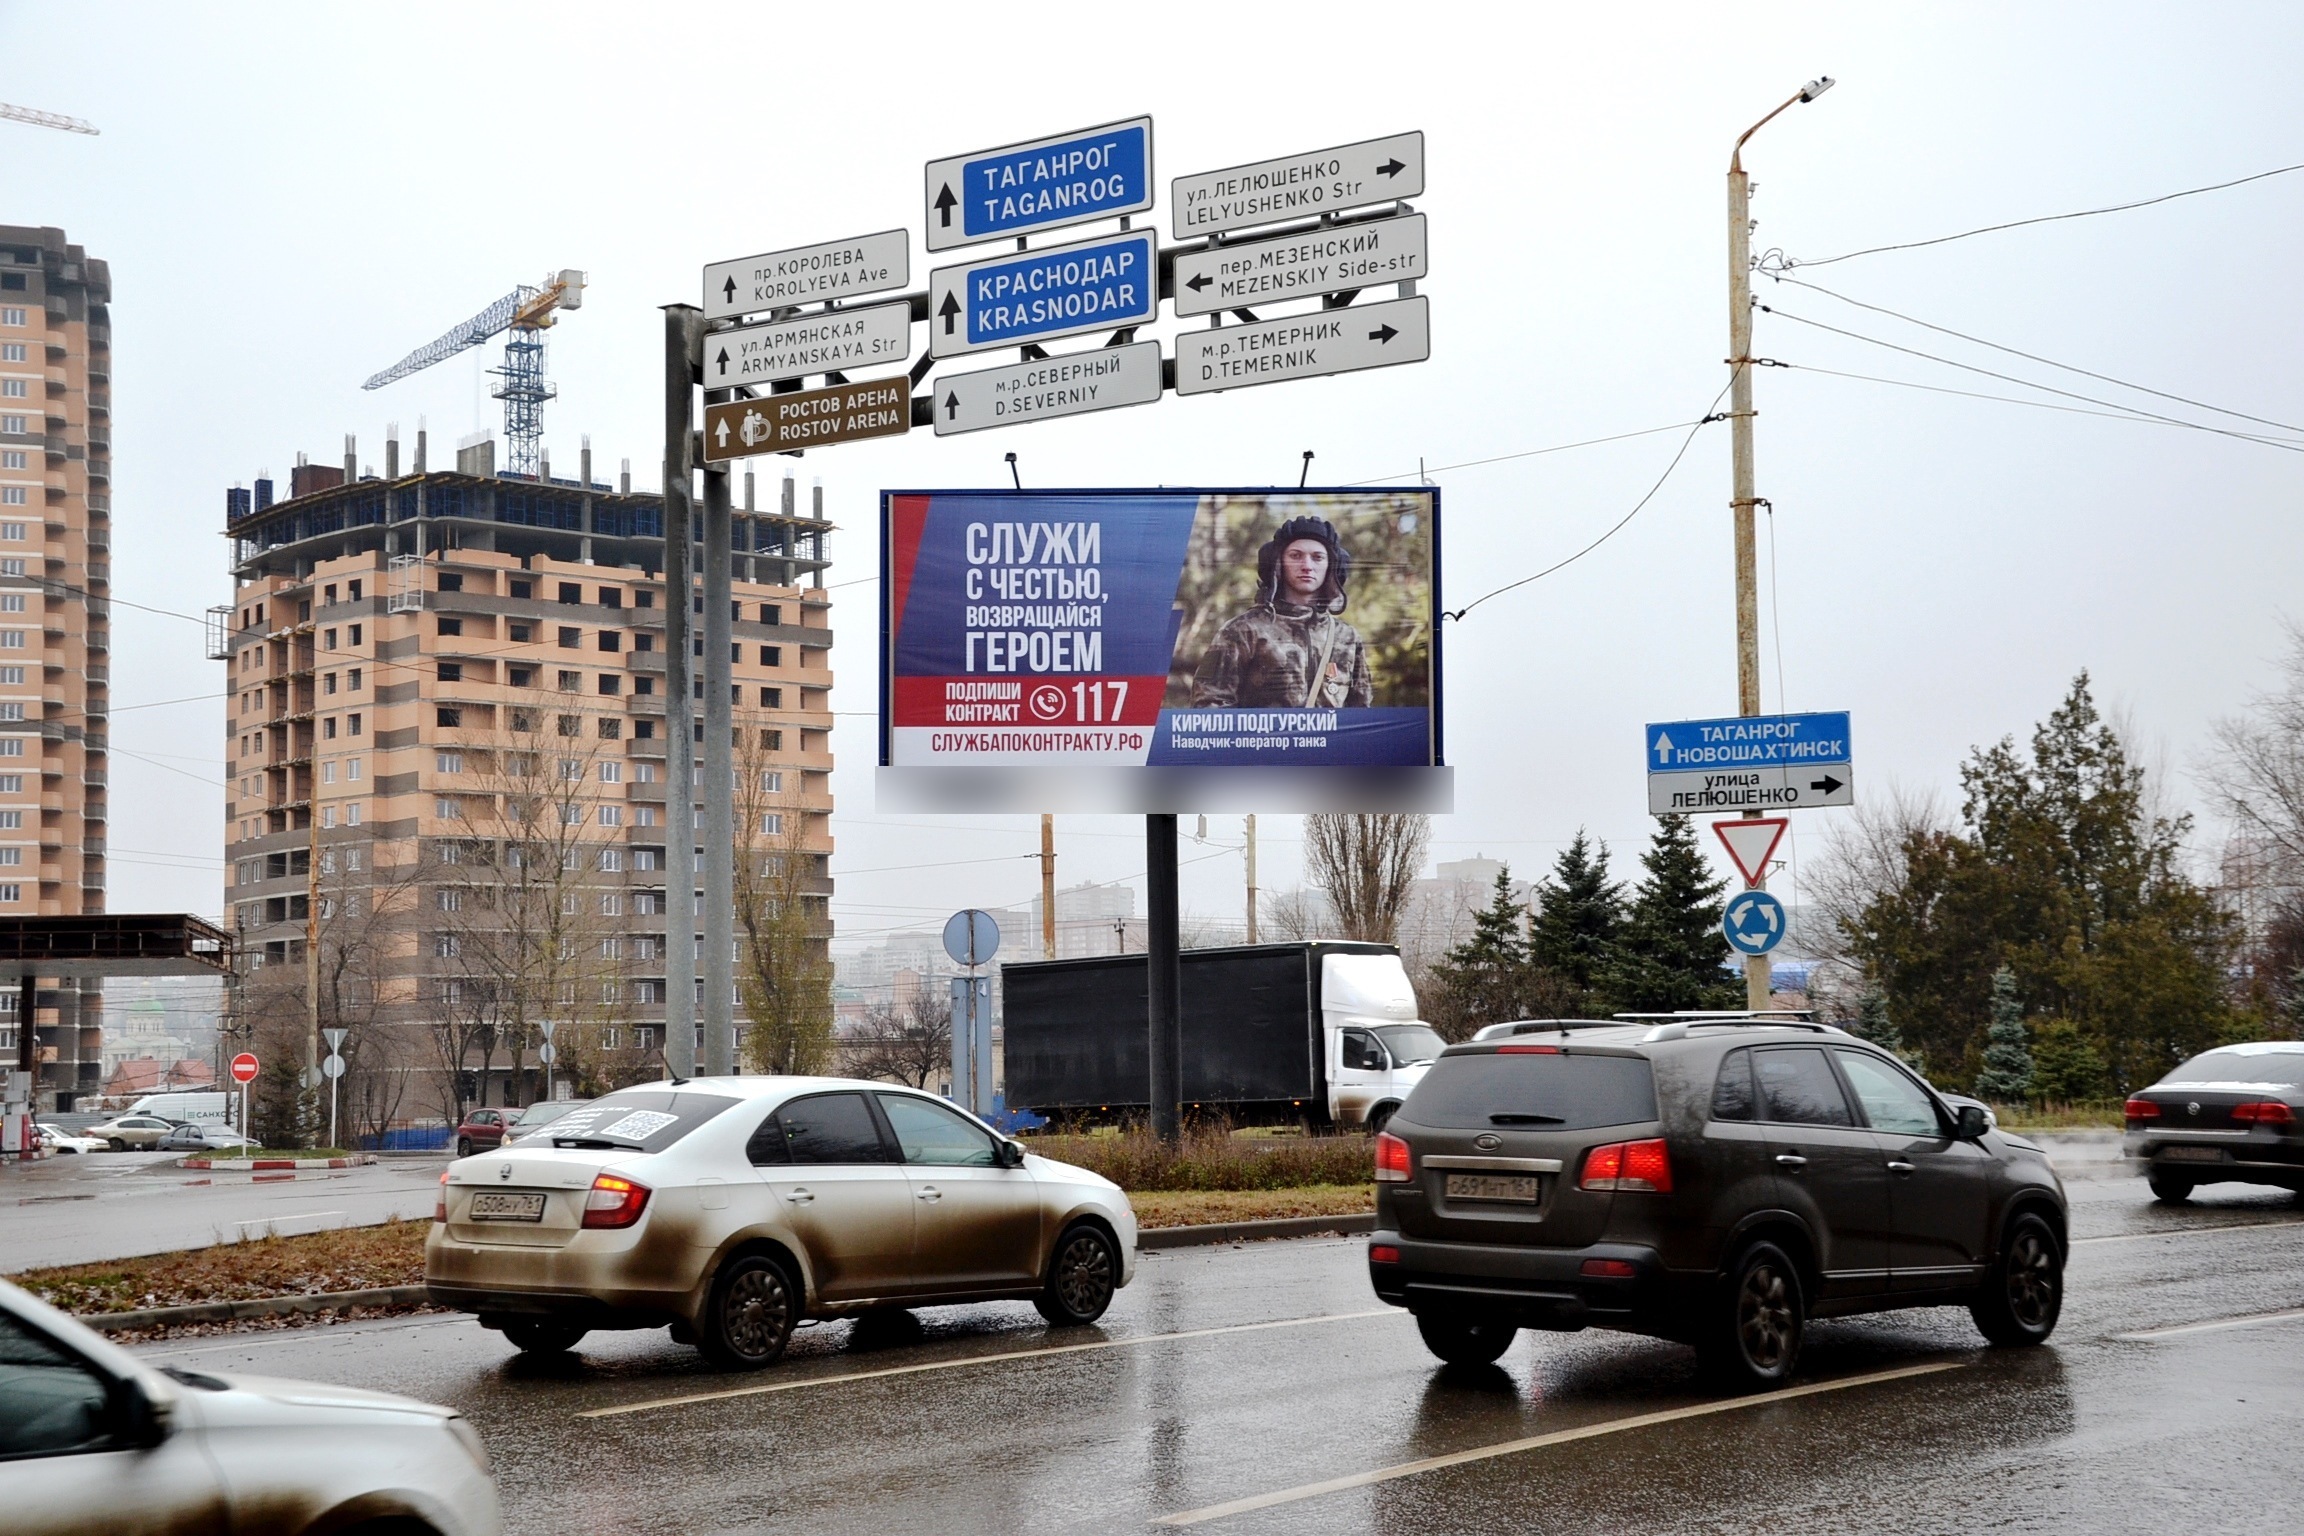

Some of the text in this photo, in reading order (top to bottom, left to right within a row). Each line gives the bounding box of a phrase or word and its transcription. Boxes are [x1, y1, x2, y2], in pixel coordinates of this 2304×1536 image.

[984, 143, 1117, 191] ТАГАНРОГ
[1187, 159, 1340, 206] ул.ЛЕЛЮШЕНКО
[985, 174, 1124, 222] TAGANROG
[1187, 180, 1363, 226] LELYUSHENKO Str
[754, 248, 864, 282] пр.КОРОЛЕВА
[1220, 228, 1379, 275] пер.МЕЗЕНСКИЙ
[754, 267, 888, 301] KOROLYEVA Ave
[978, 251, 1134, 302] КРАСНОДАР
[1221, 253, 1416, 298] MEZENSKIY Side-str
[979, 283, 1136, 332] KRASNODAR
[741, 320, 865, 357] ул.АРМЯНСКАЯ
[1202, 321, 1342, 359] м.р.ТЕМЕРНИК
[741, 338, 897, 374] ARMYANSKAYA Str
[1202, 349, 1317, 381] D.TEMERNIK
[995, 354, 1121, 394] м.р.СЕВЕРНЫЙ
[779, 388, 899, 420] РОСТОВ АРЕНА
[996, 384, 1099, 416] D.SEVERNIY
[780, 409, 899, 441] ROSTOV ARENA
[966, 522, 1101, 565] СЛУЖИ
[966, 568, 1109, 603] С ЧЕСТЬЮ,
[966, 602, 1102, 629] ВОЗВРАЩАЙСЯ
[966, 631, 1102, 672] ГЕРОЕМ
[945, 682, 1021, 702] ПОДПИШИ
[1071, 681, 1129, 722] 117
[945, 704, 1020, 722] КОНТРАКТ
[1171, 709, 1338, 733] КИРИЛЛ ПОДГУРСКИЙ
[931, 732, 1143, 752] СЛУЖБАПОКОНТРАКТУ.РФ
[1171, 734, 1327, 750] Наводчик-оператор танка
[1700, 722, 1802, 743] ТАГАНРОГ
[1676, 740, 1842, 764] НОВОШАХТИНСК
[1671, 788, 1799, 808] ЛЕЛЮШЕНКО
[1704, 773, 1760, 790] улица
